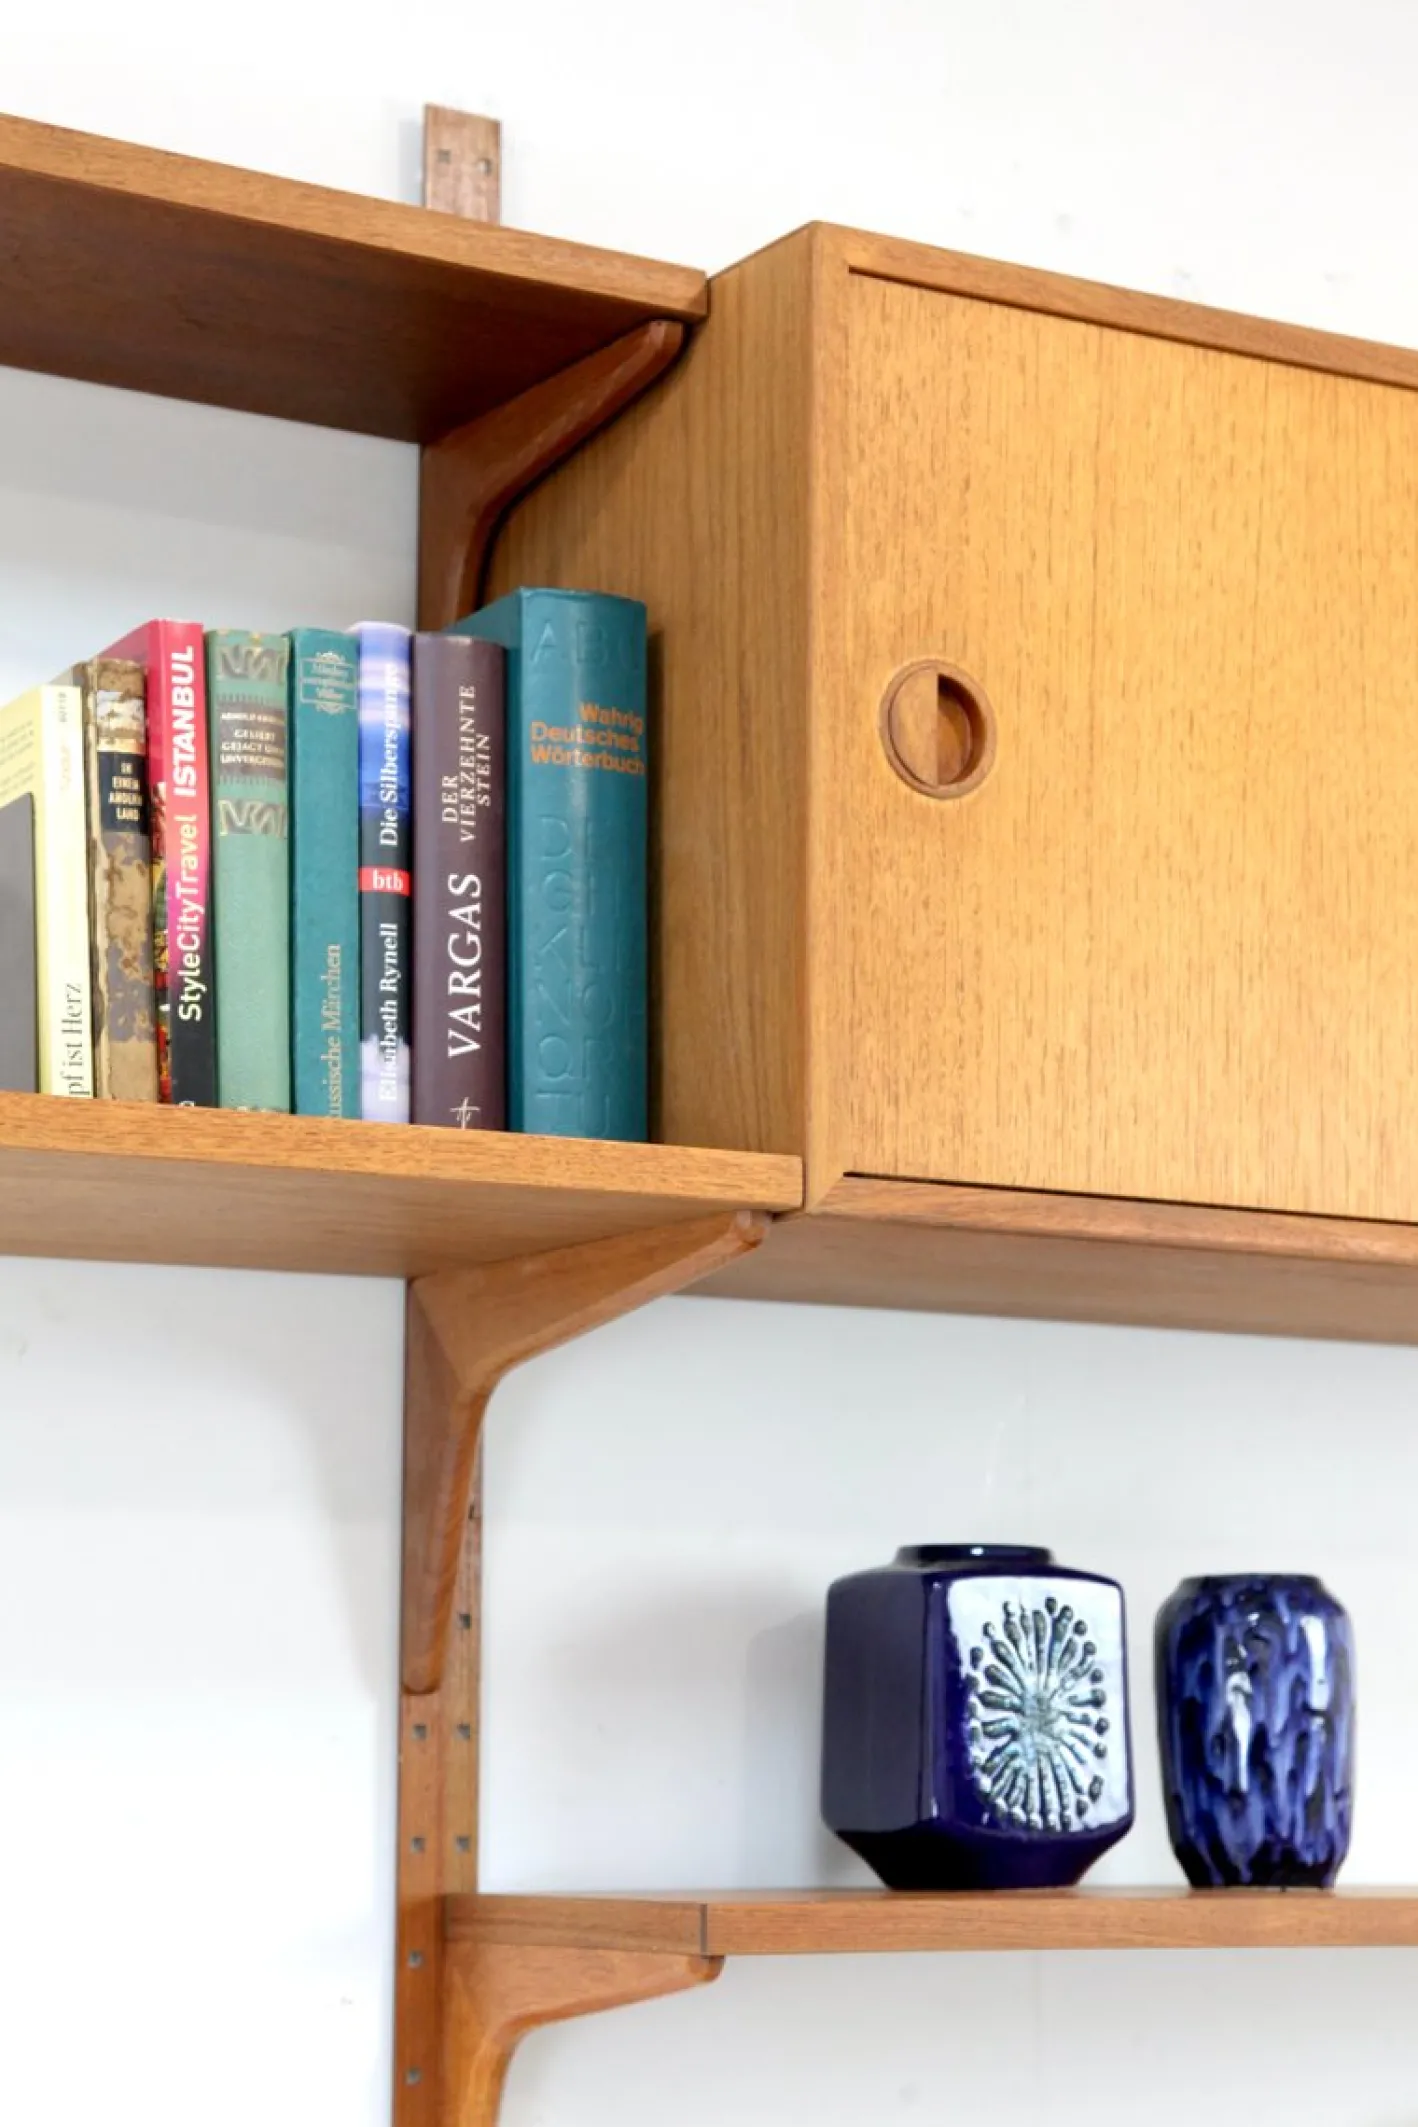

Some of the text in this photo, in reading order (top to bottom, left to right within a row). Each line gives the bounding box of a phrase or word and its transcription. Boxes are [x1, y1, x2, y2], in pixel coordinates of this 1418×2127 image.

[530, 721, 640, 752] Deutsches
[580, 701, 644, 735] Wahrig
[459, 685, 476, 842] VIERZEHNTE
[476, 733, 491, 806] STEIN
[530, 743, 646, 776] Wörterbuch
[441, 775, 458, 823] DER
[171, 645, 207, 1021] StyleCityTravel ISTANBUL
[379, 806, 398, 846] Die
[372, 869, 404, 891] btb
[379, 923, 402, 992] Rynell
[447, 873, 482, 1058] VARGAS
[61, 983, 83, 1034] Herz
[62, 1043, 84, 1066] ist
[320, 1036, 342, 1118] ussische
